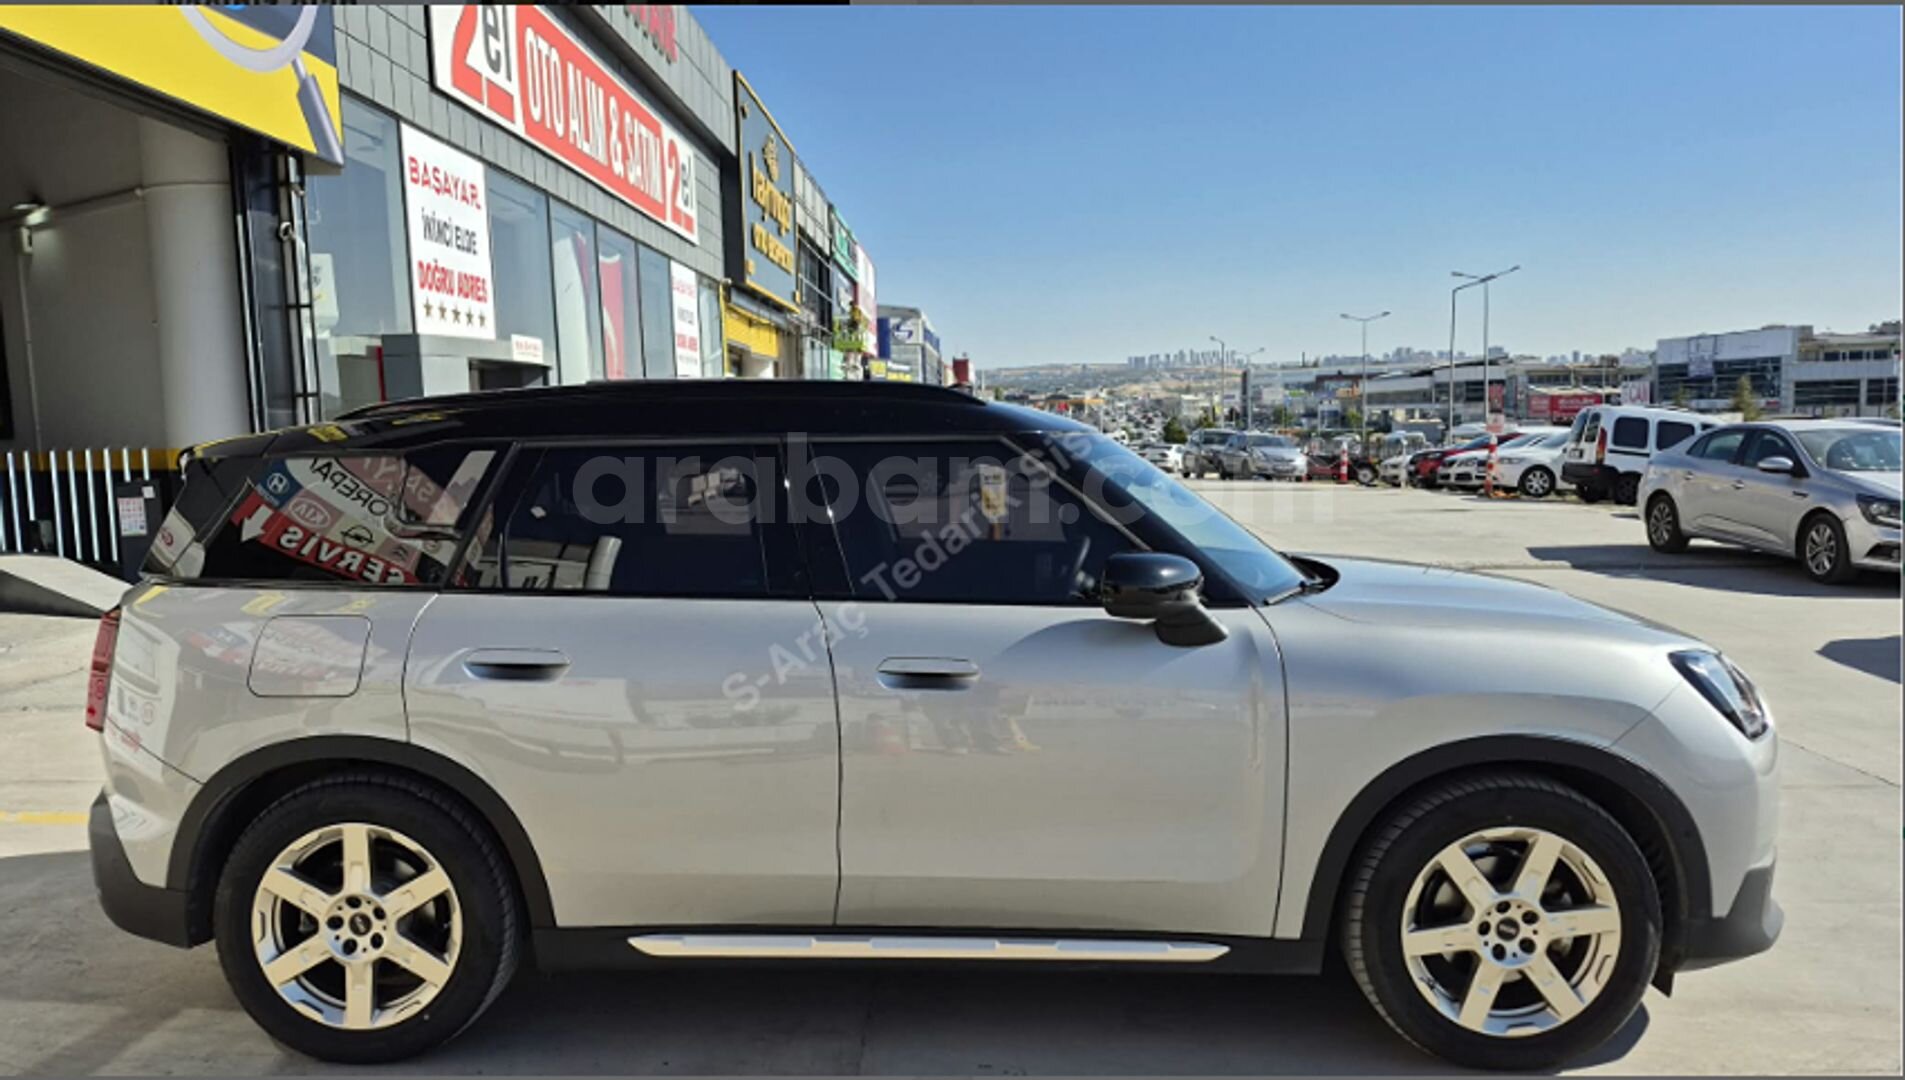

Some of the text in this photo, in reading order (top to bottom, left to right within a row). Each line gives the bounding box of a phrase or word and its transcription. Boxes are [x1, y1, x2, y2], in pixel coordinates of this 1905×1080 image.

[525, 27, 564, 138] OTO
[567, 61, 608, 167] ALIM
[609, 95, 624, 178] &
[623, 110, 663, 205] SATIM
[408, 156, 481, 210] BAŞAYAR
[455, 225, 478, 255] ELDE
[418, 258, 488, 303] DOĞRU ADRES
